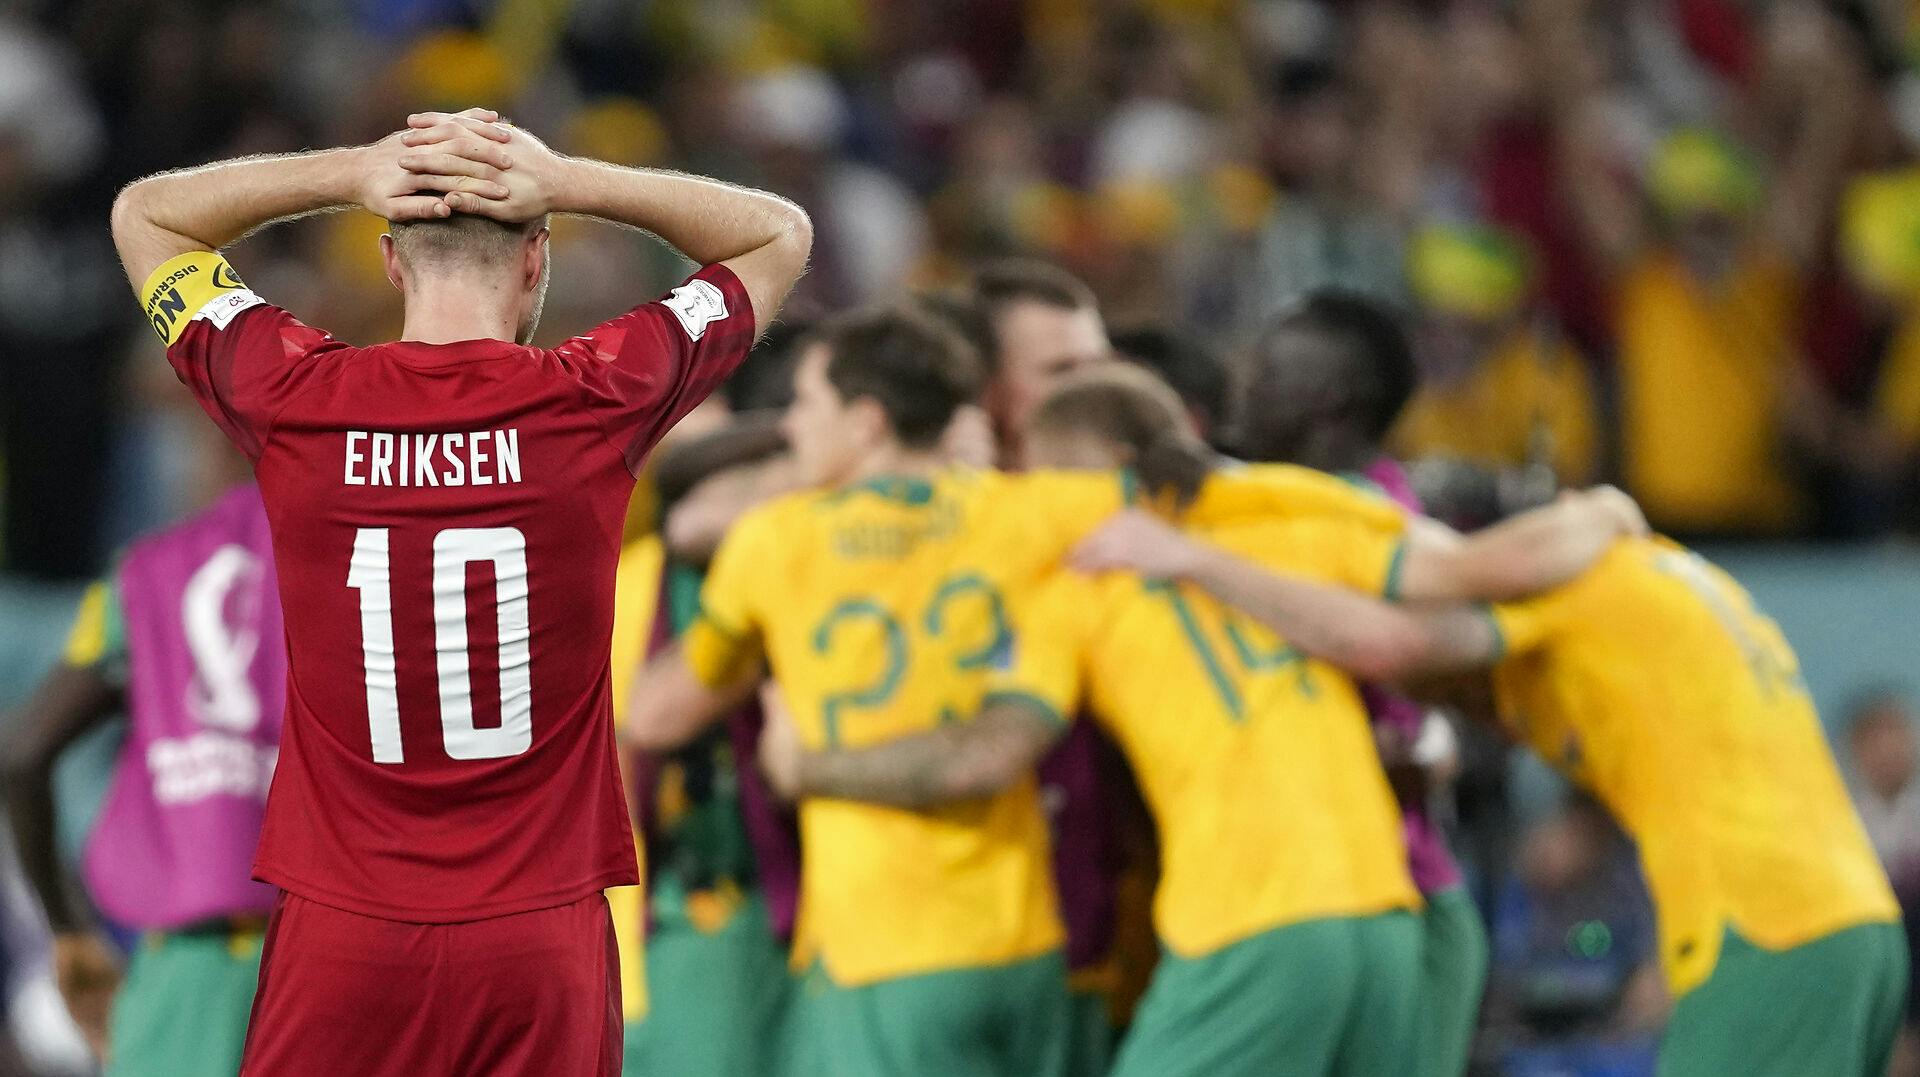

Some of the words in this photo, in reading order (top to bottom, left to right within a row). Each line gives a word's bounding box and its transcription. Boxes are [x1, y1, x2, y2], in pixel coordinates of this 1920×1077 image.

[146, 264, 199, 320] DISCRIMIN
[153, 287, 187, 345] NO
[345, 429, 521, 486] ERIKSEN
[347, 527, 531, 763] 10
